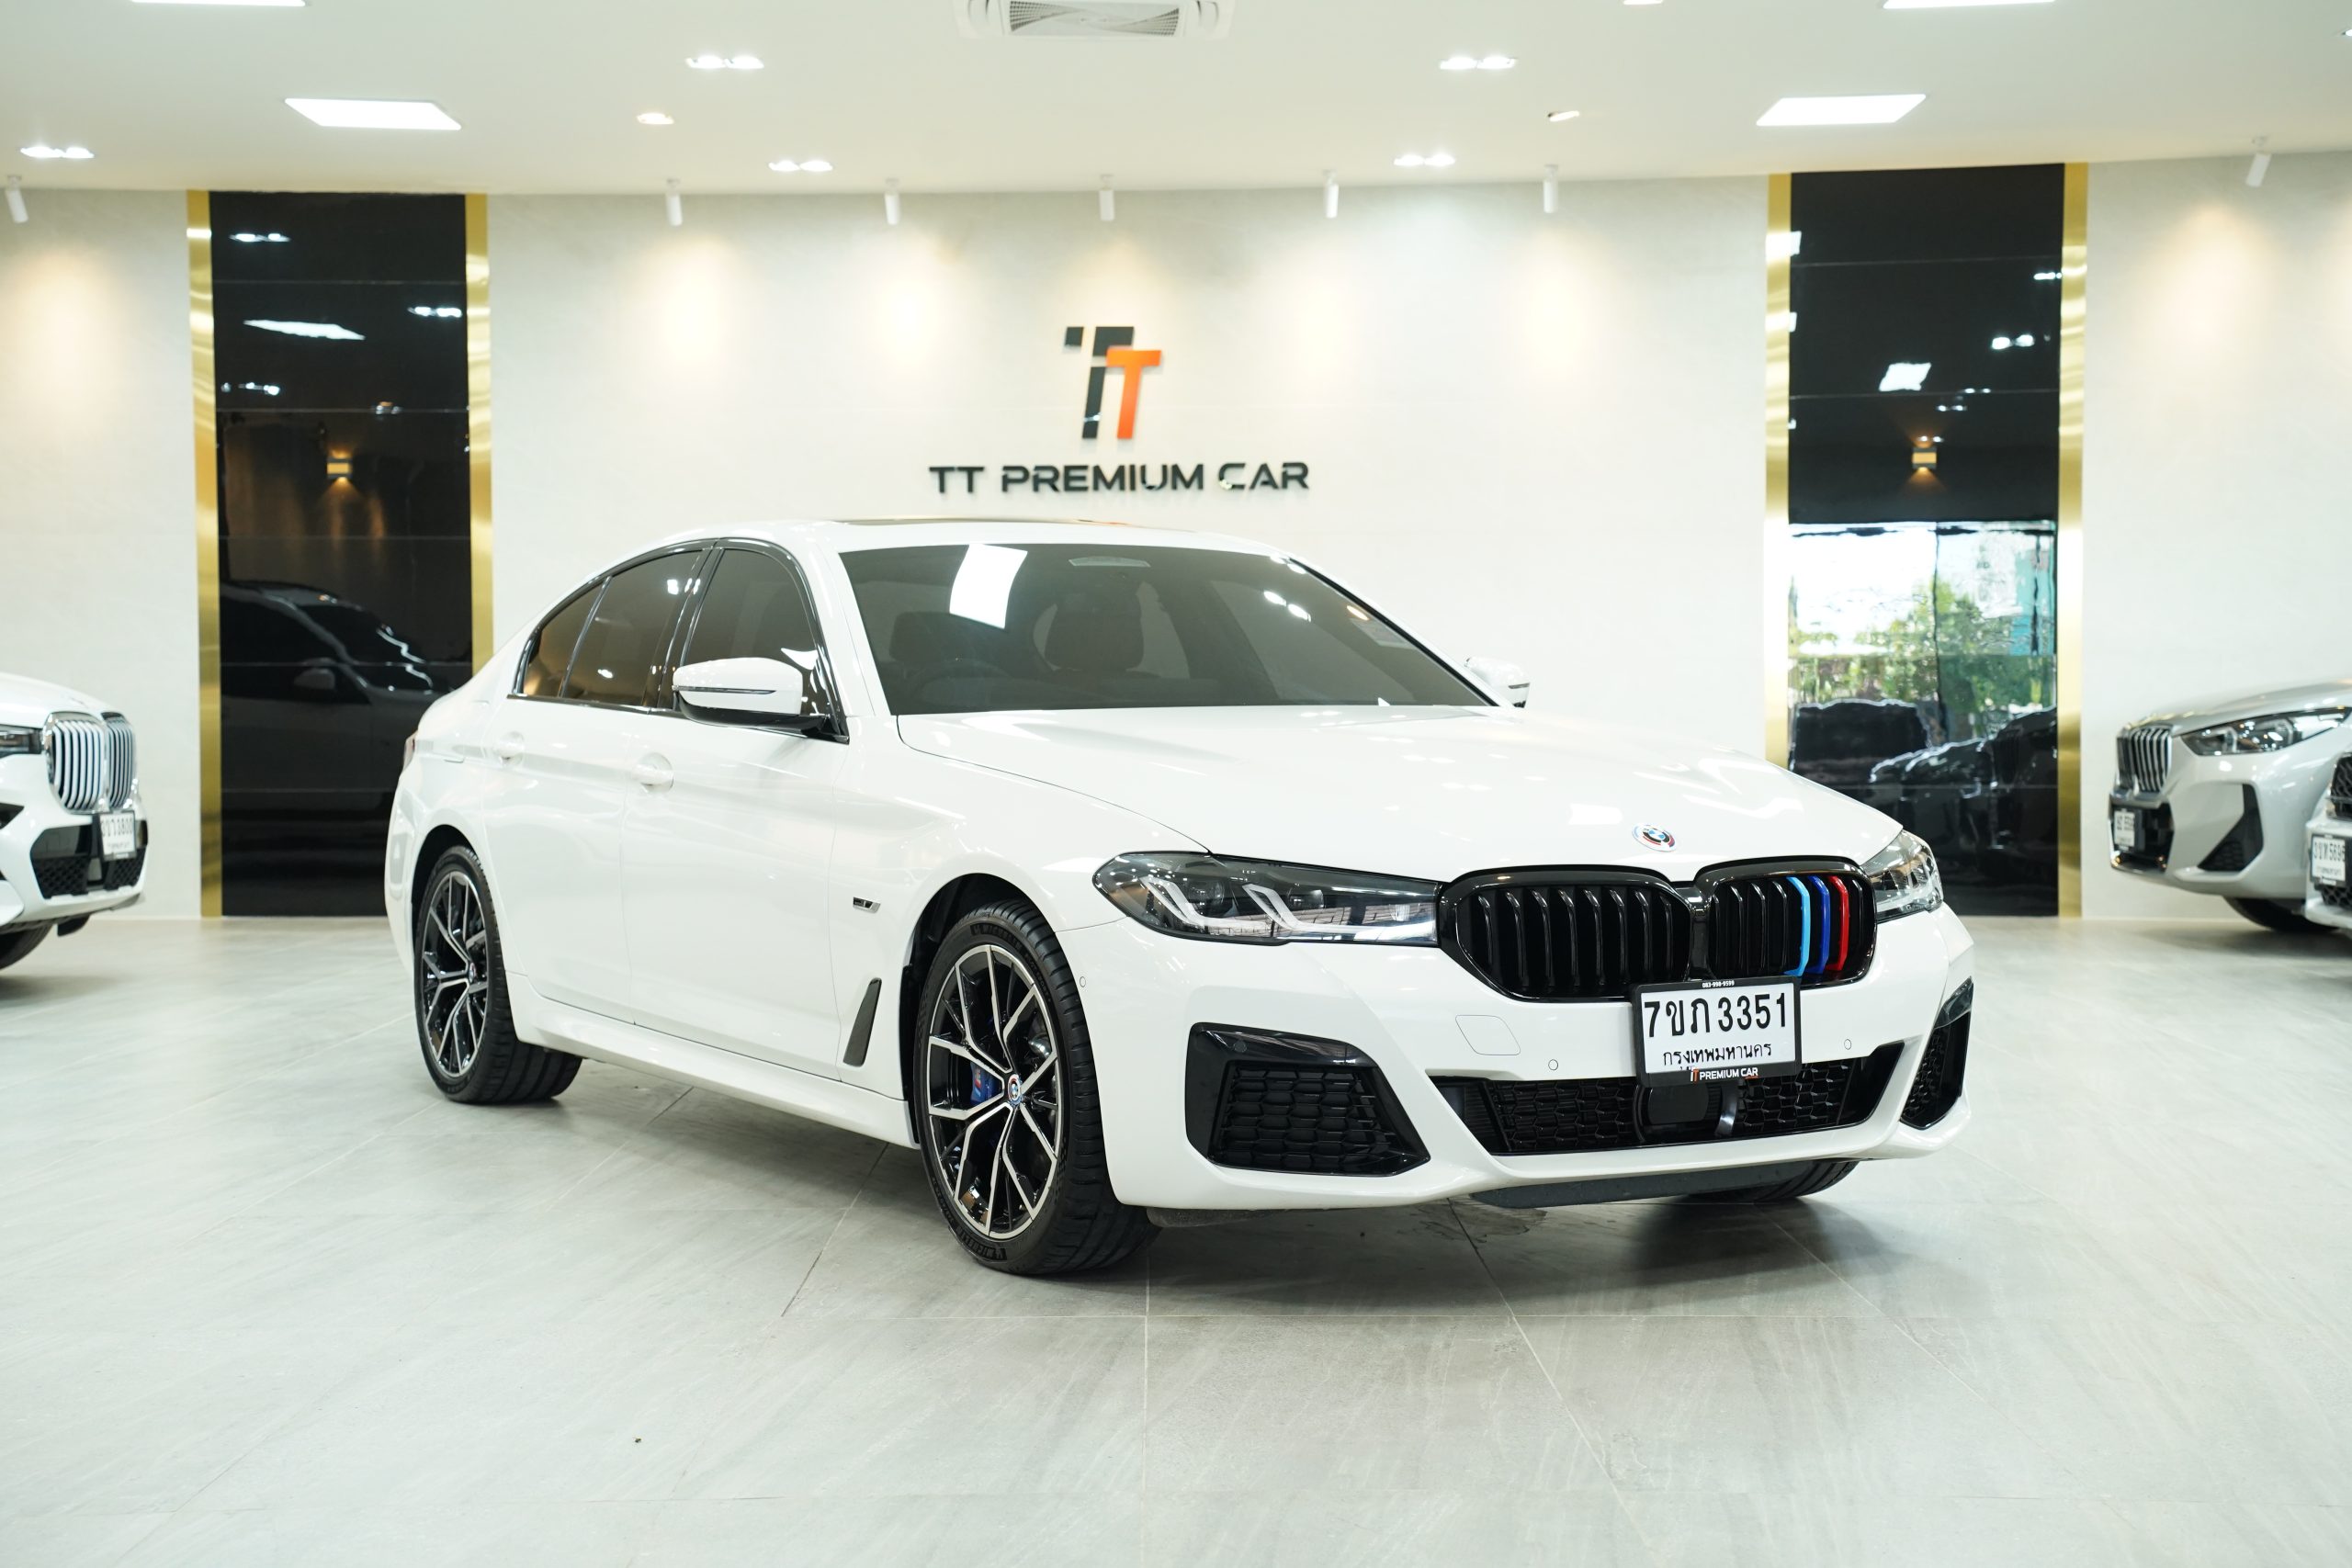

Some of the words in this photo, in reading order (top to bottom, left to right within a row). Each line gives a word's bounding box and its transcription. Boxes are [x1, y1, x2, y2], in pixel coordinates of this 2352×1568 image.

[929, 465, 985, 493] TT
[1001, 463, 1204, 492] PREMIUM
[1218, 461, 1310, 491] CAR
[1644, 998, 1711, 1038] 7ขภ
[1717, 992, 1786, 1032] 3351
[1663, 1043, 1772, 1070] กรุงเทพมหานคร
[1700, 1068, 1739, 1081] PREMIUM
[1740, 1066, 1758, 1077] CAR
